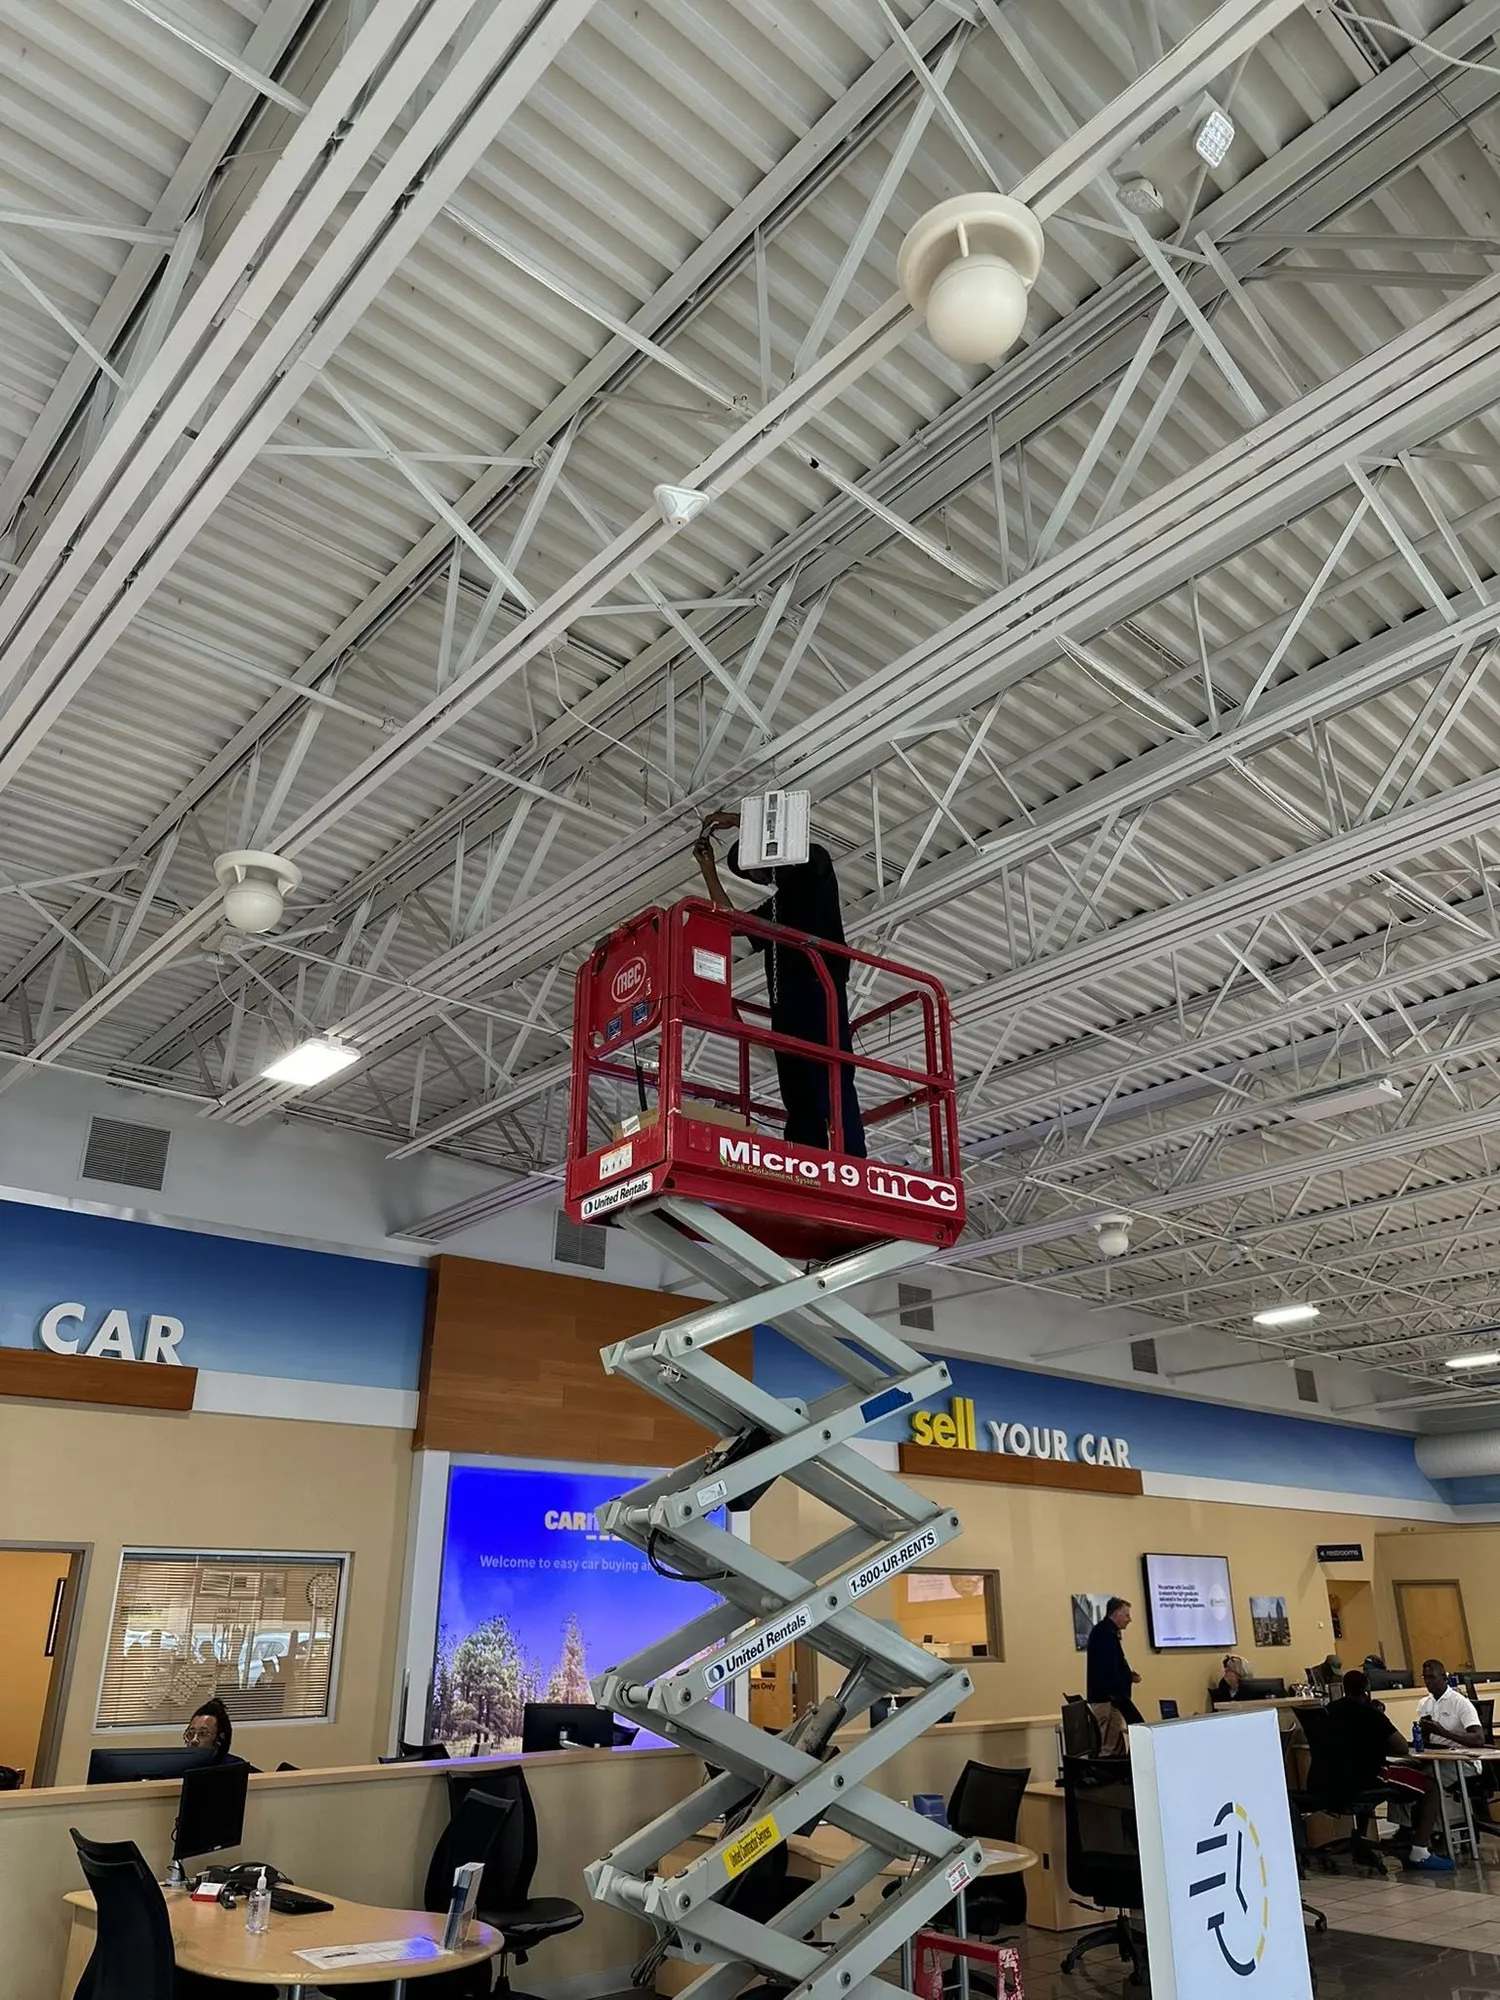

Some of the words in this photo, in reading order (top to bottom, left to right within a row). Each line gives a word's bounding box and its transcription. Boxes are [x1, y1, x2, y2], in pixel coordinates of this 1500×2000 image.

[719, 1137, 860, 1187] Micro19
[727, 1161, 745, 1171] Leak
[747, 1166, 793, 1180] Containment
[795, 1175, 821, 1187] System
[593, 1190, 619, 1211] United
[620, 1179, 649, 1204] Rentals
[41, 1302, 185, 1366] CAR
[911, 1396, 977, 1451] sell
[987, 1420, 1070, 1462] YOUR
[1079, 1432, 1132, 1469] CAR
[480, 1555, 537, 1568] Welcome
[539, 1557, 551, 1569] to
[553, 1559, 579, 1572] easy
[582, 1560, 600, 1570] car
[601, 1558, 639, 1574] buying
[849, 1530, 935, 1594] 1-800-UR-RENTS
[1326, 1549, 1360, 1557] restrooms
[725, 1641, 765, 1673] United
[766, 1613, 808, 1648] Rentals
[761, 1682, 777, 1691] Only
